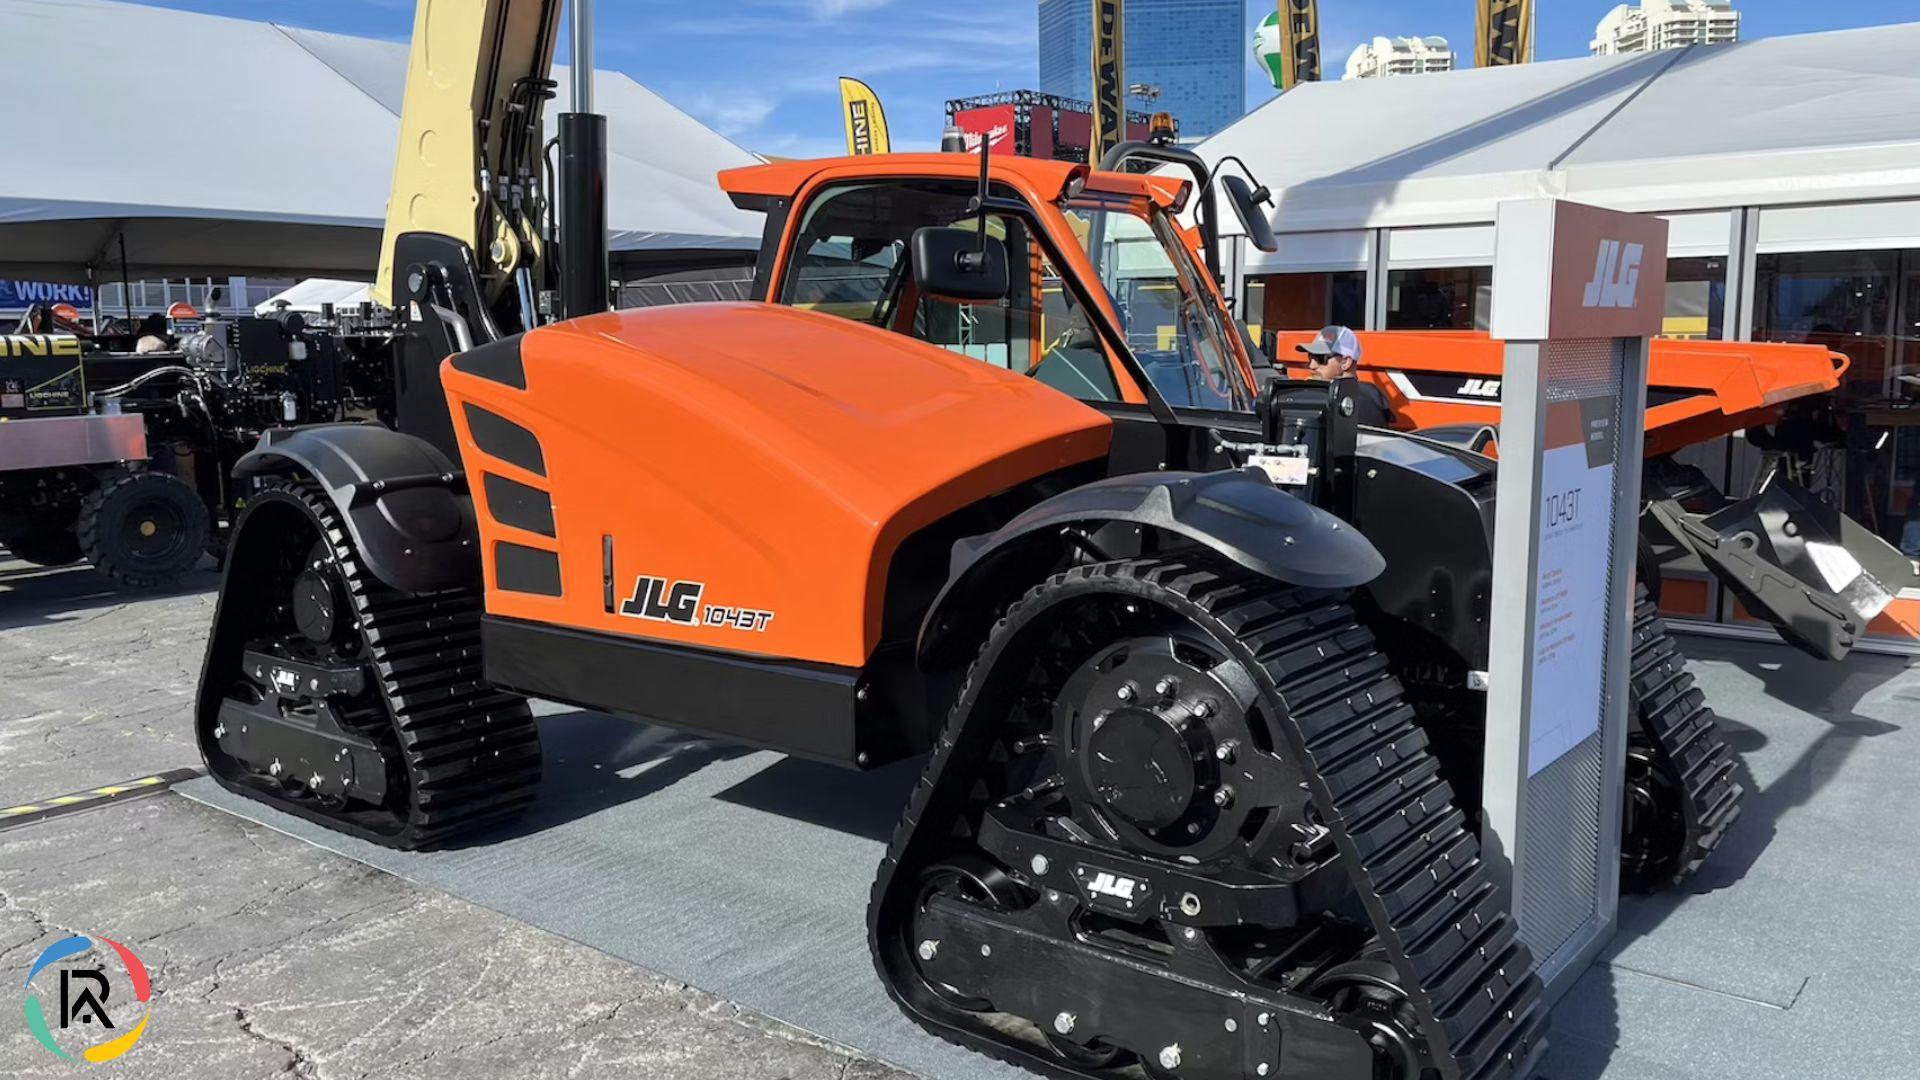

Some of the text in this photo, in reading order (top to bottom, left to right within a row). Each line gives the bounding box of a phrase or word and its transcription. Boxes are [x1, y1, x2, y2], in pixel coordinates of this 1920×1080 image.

[1582, 239, 1644, 308] JLG
[1456, 379, 1501, 397] JLG
[1545, 487, 1582, 528] 1043T
[620, 575, 774, 632] JLG 1043T
[1086, 872, 1136, 900] JLG
